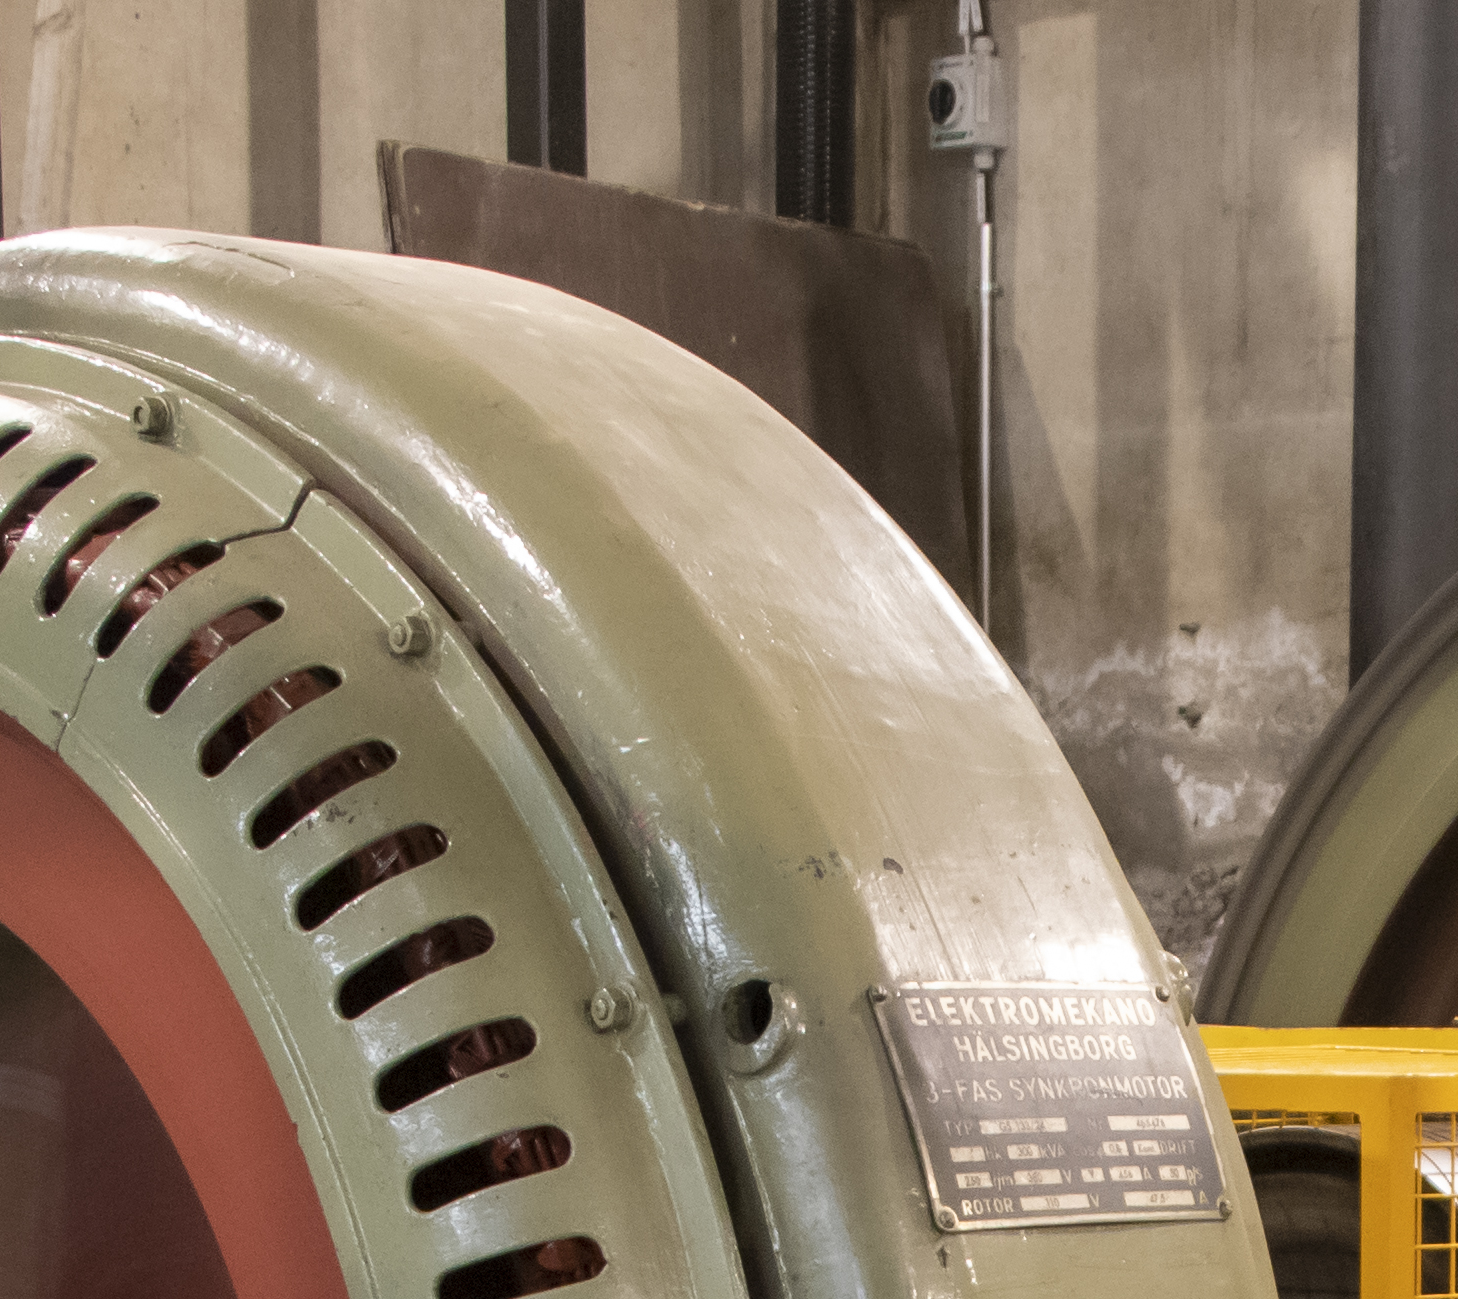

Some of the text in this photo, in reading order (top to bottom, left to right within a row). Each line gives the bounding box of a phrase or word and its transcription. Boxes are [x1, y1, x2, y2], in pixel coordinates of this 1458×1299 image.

[905, 996, 1157, 1027] ELEKTROMEKANO
[953, 1030, 1137, 1062] HÄLSINGBORG
[926, 1075, 1188, 1103] 3-FAS SYNKRONMOTOR
[943, 1119, 973, 1136] TYP
[1062, 1168, 1072, 1184] V
[1143, 1166, 1153, 1181] A
[961, 1197, 1014, 1217] ROTOR
[1089, 1193, 1099, 1208] V
[1199, 1190, 1210, 1205] A
